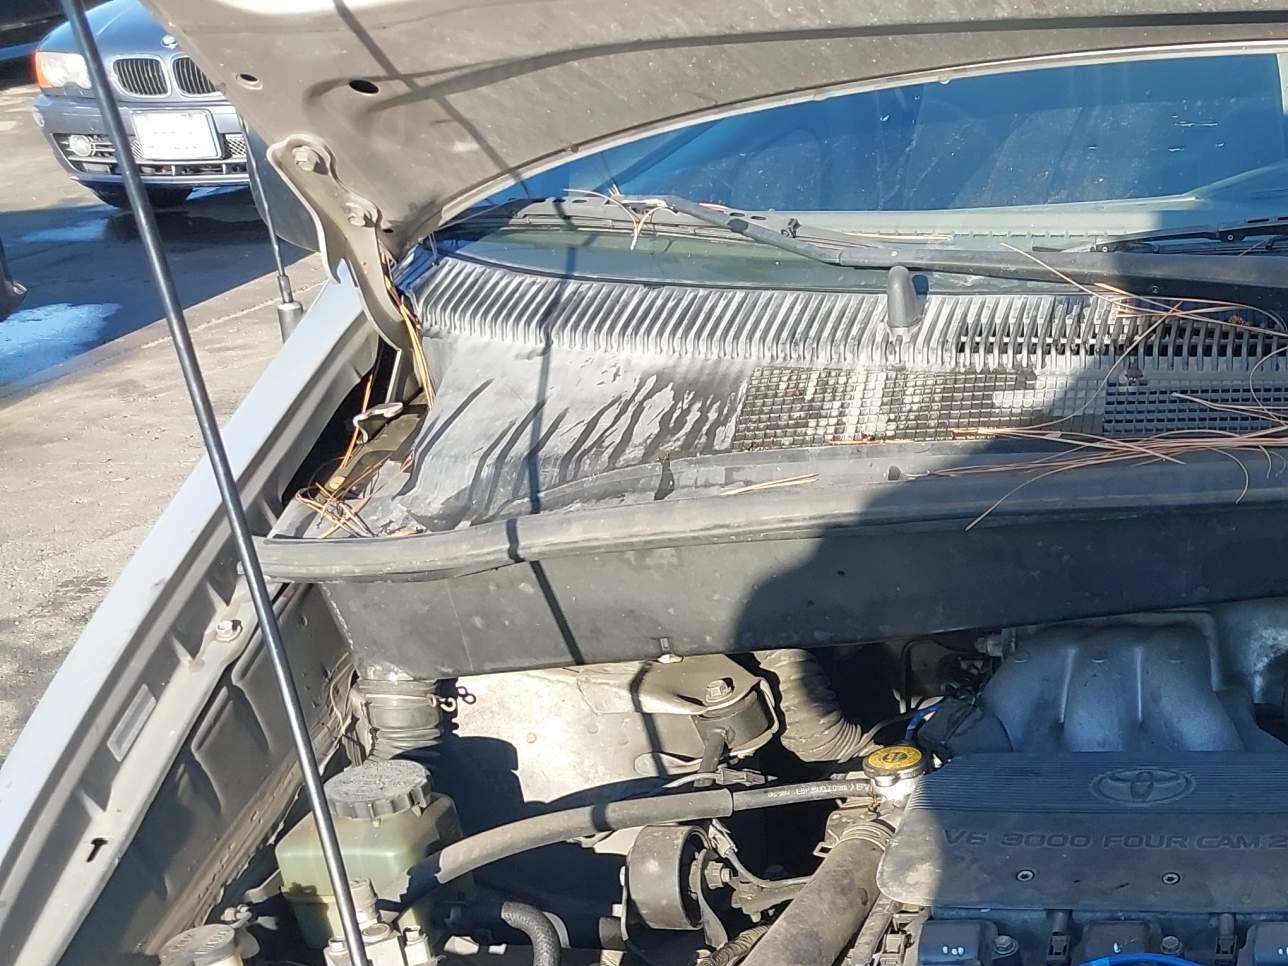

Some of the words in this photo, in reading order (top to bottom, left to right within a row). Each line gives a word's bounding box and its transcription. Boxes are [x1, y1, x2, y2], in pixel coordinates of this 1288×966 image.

[943, 829, 989, 846] V6
[1000, 832, 1091, 849] 3000
[1103, 832, 1189, 849] FOUR
[1197, 833, 1260, 849] CAM
